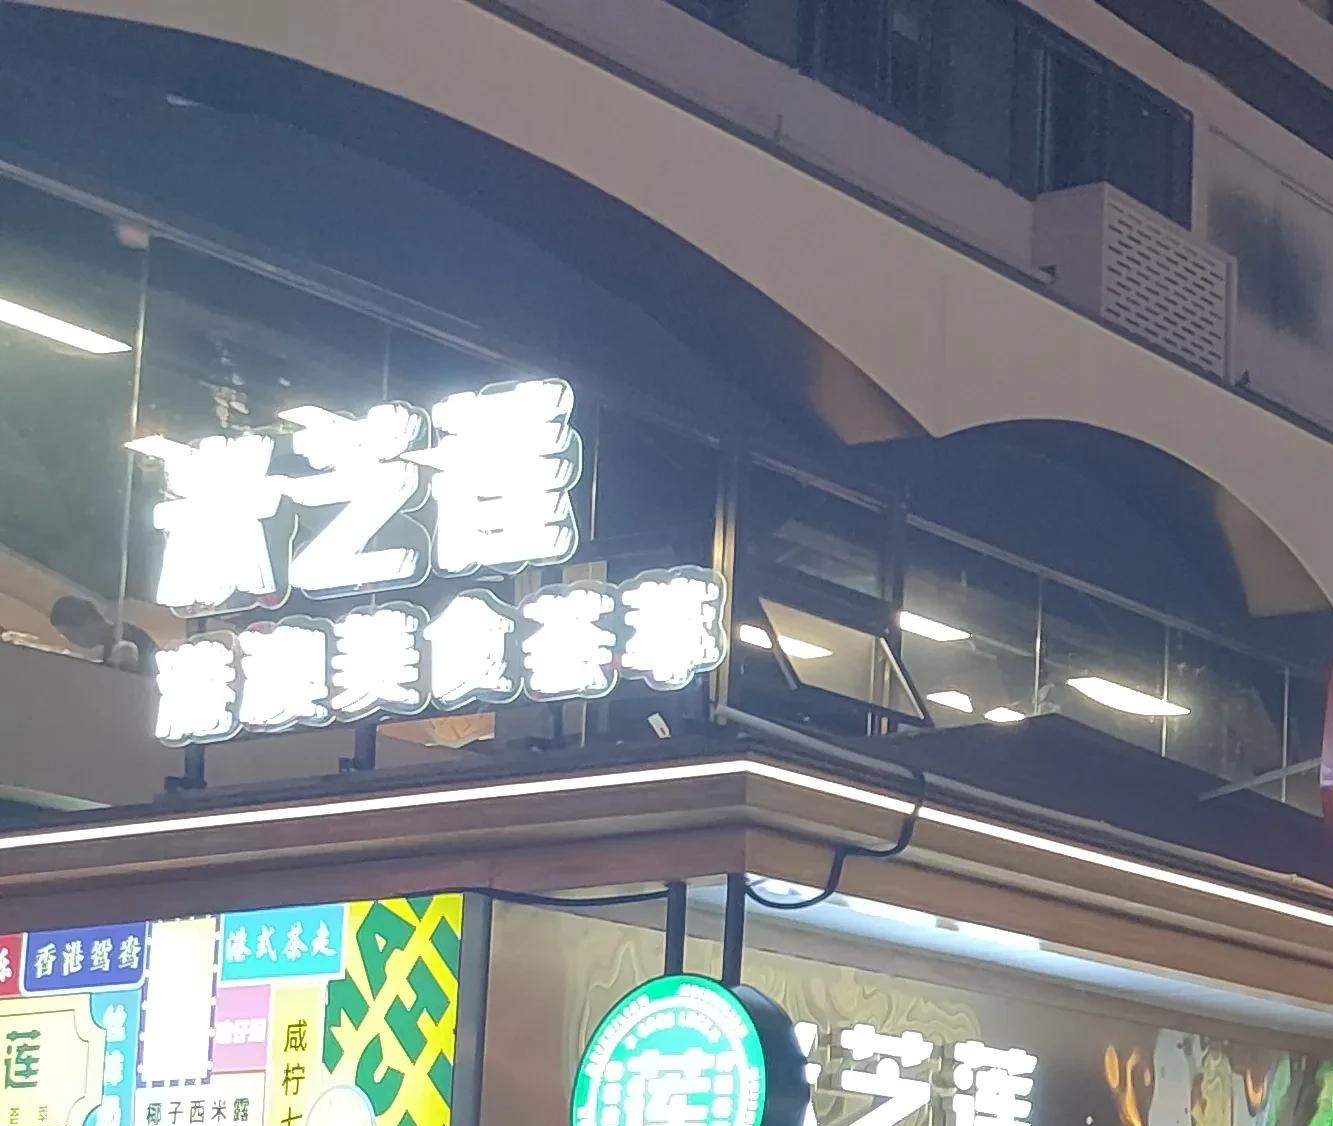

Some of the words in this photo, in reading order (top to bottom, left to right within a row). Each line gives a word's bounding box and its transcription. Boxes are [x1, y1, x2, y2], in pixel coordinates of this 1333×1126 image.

[146, 1098, 250, 1126] 椰子西米露
